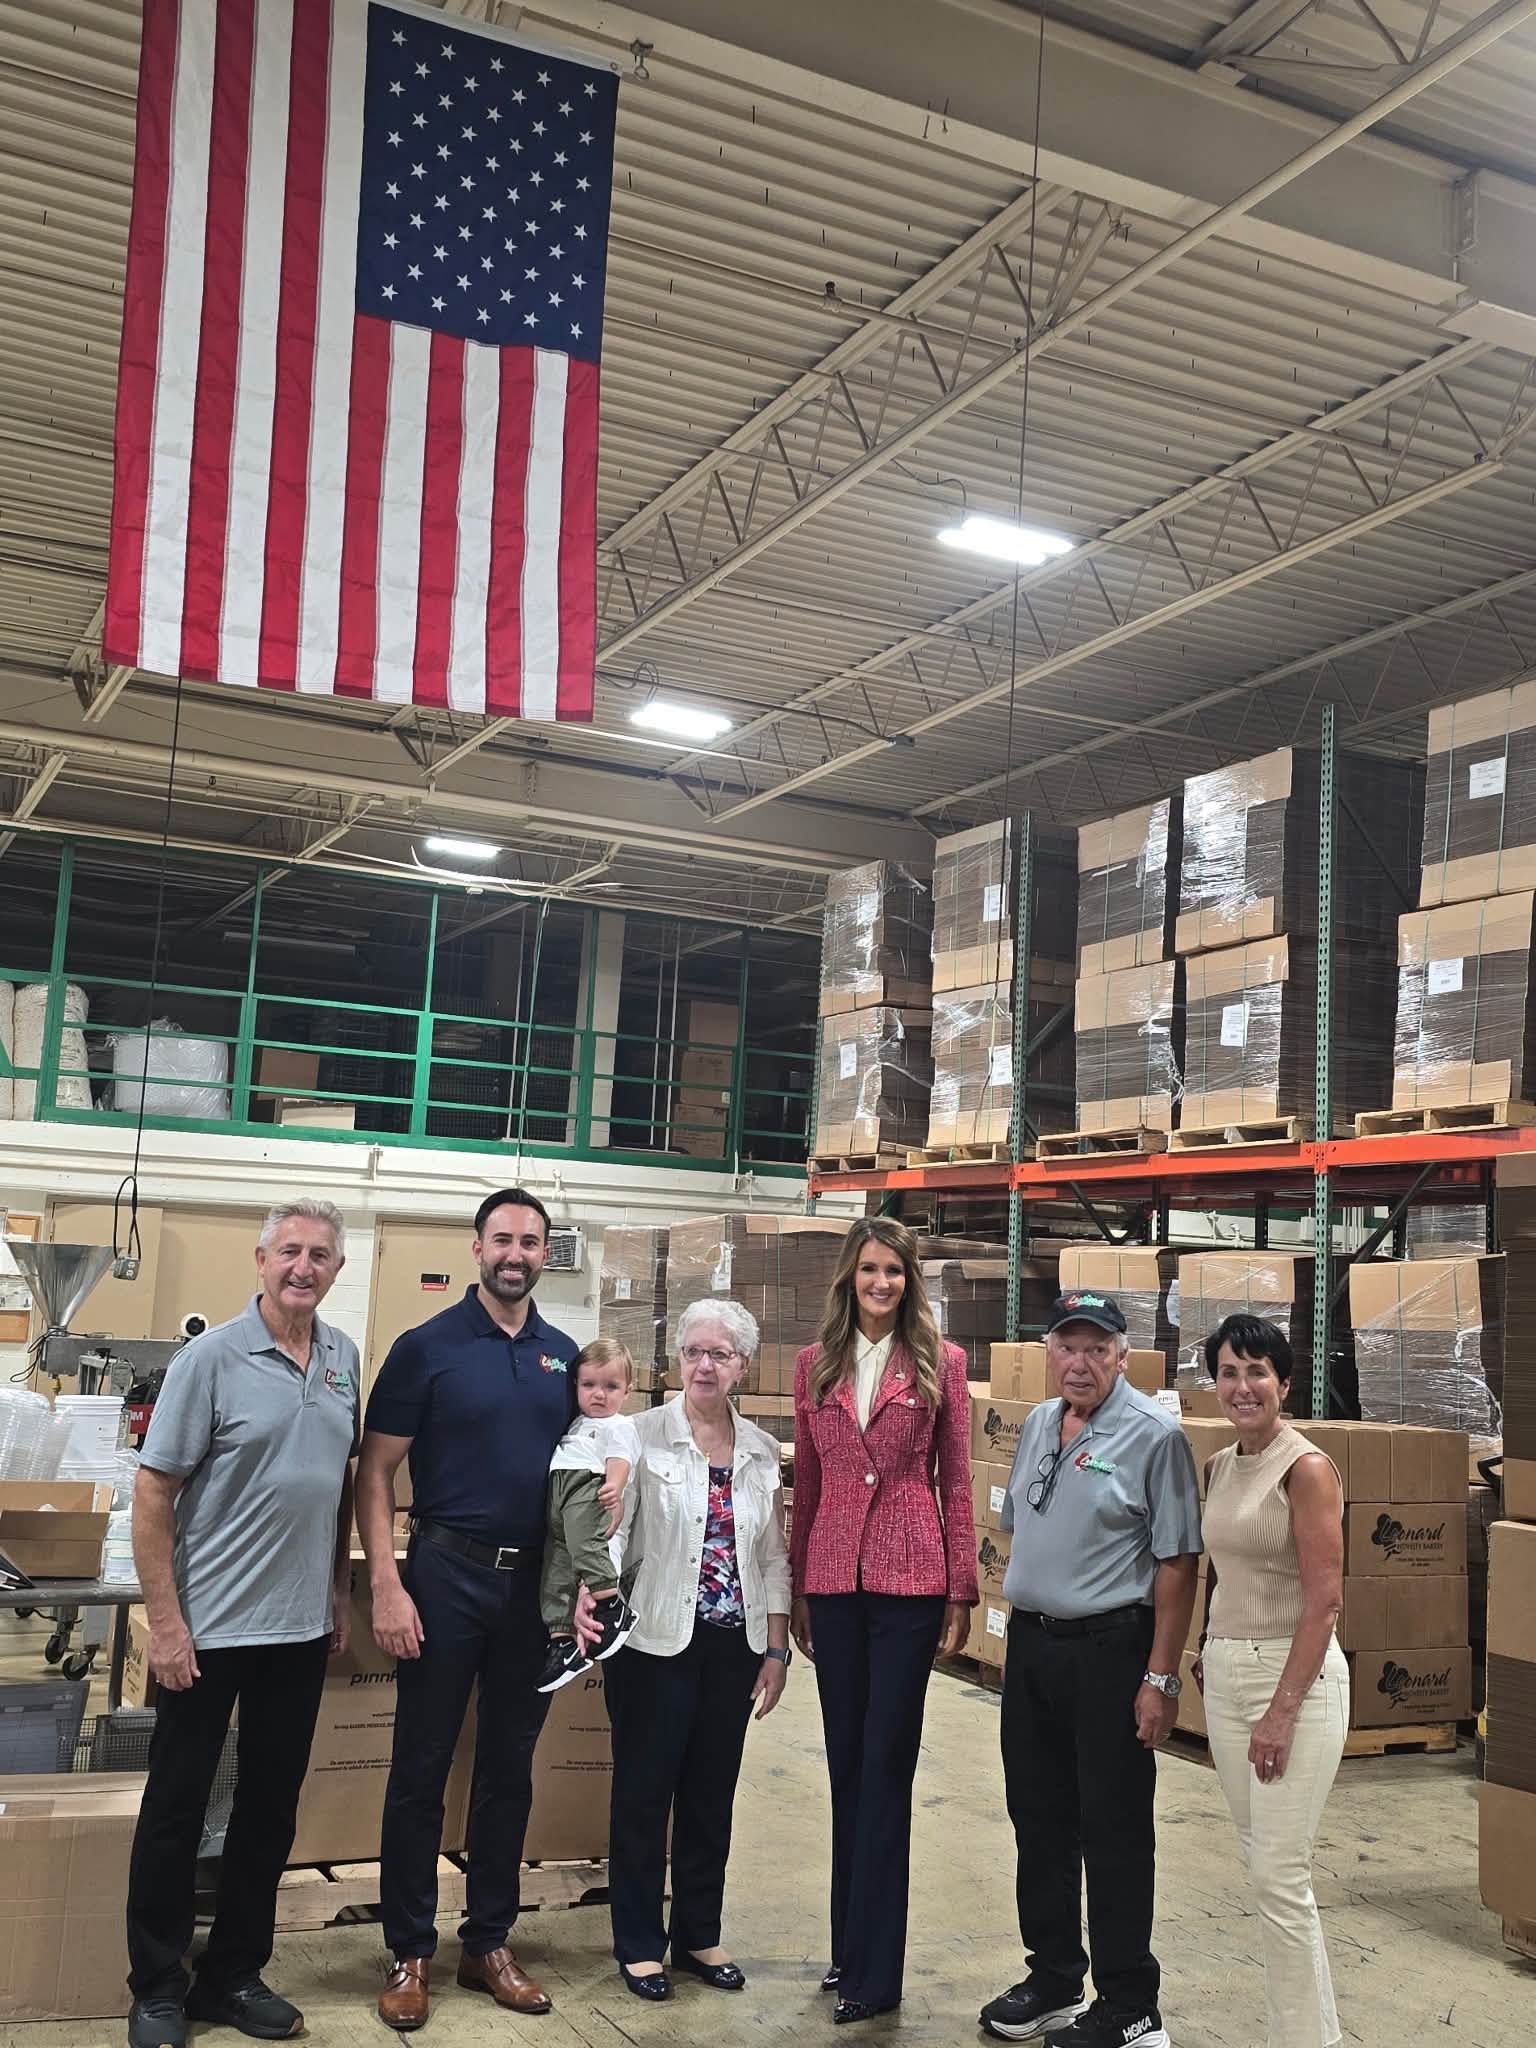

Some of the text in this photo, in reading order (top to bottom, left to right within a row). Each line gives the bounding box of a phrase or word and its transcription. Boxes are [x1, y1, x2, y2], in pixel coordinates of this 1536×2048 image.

[1381, 1519, 1446, 1541] Leonard
[1386, 1667, 1452, 1690] Leonard
[1122, 2015, 1152, 2042] HOKA
